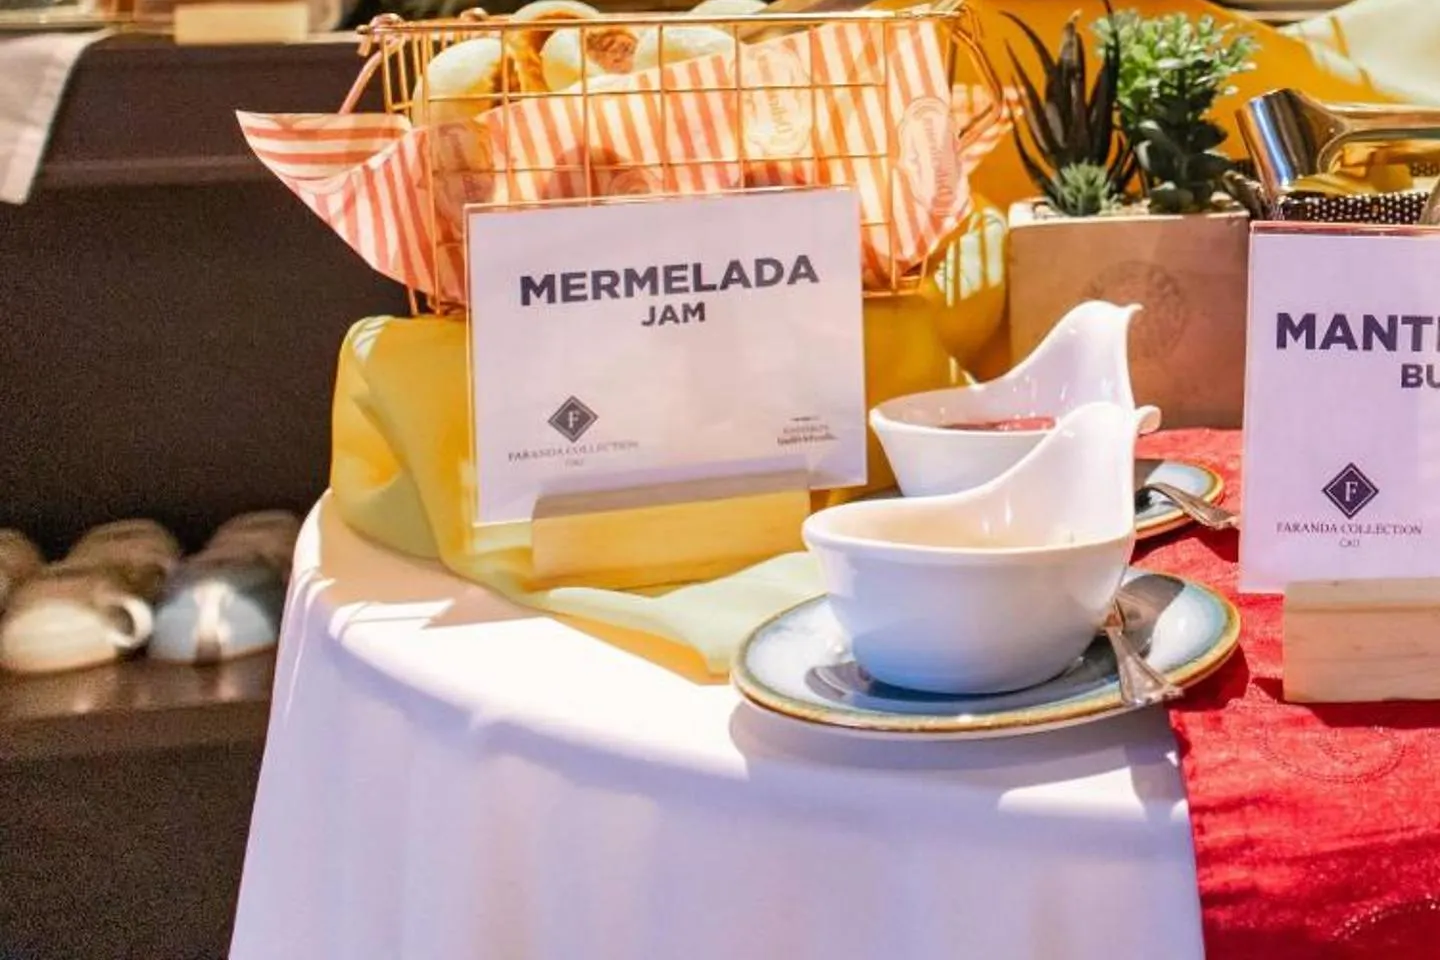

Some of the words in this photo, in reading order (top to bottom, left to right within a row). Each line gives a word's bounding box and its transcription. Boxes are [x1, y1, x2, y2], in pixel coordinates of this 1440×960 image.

[520, 254, 820, 307] MERMELADA
[641, 301, 706, 327] JAM
[1276, 522, 1338, 534] FARANDA
[1341, 523, 1423, 535] COLLECTION
